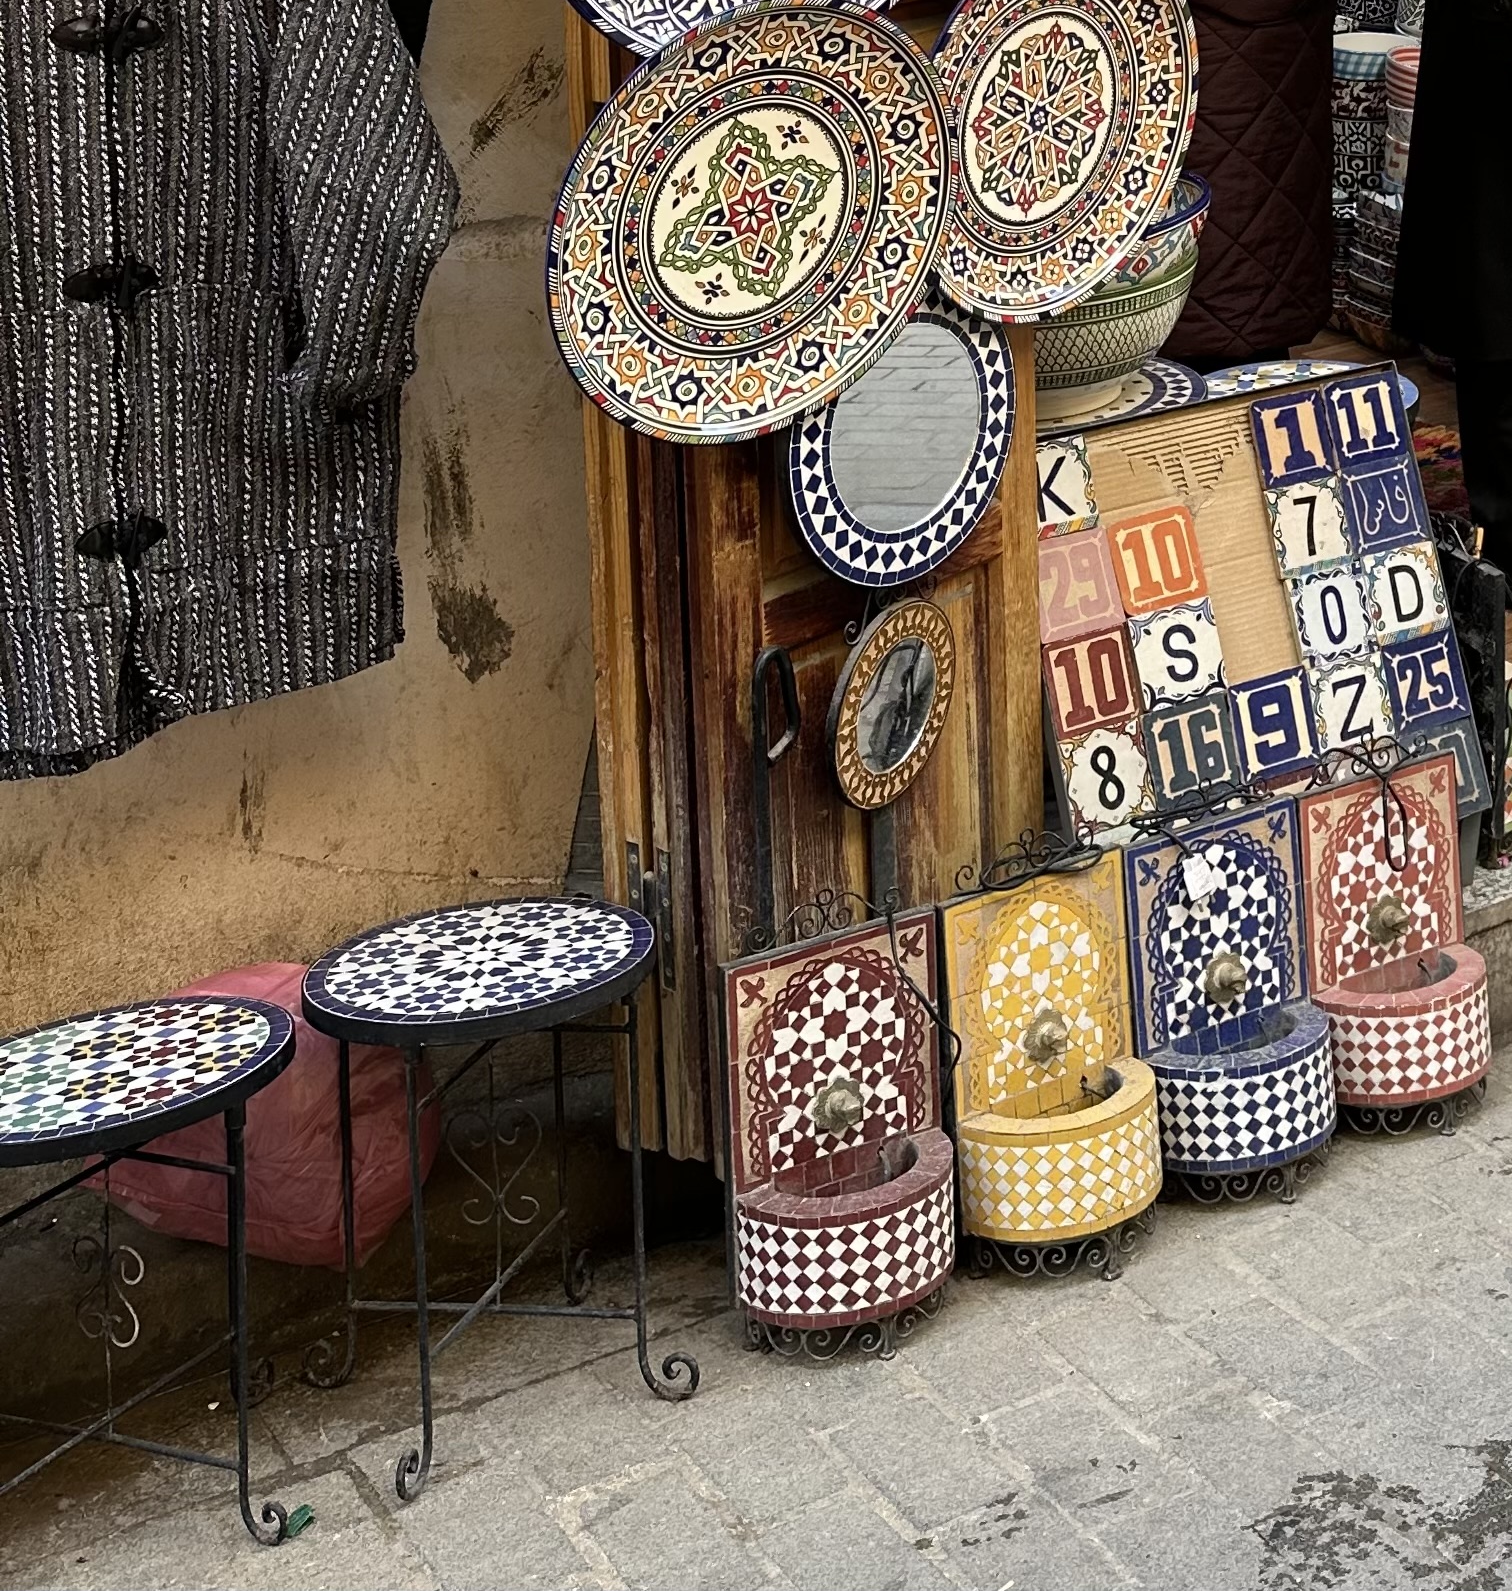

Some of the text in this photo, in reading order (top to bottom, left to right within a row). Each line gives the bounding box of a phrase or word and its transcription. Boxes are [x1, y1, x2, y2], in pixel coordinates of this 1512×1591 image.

[1273, 406, 1318, 474] 1
[1337, 384, 1396, 452] 11
[1036, 455, 1076, 523] K
[1292, 495, 1318, 557] 7
[1039, 542, 1111, 625] 29
[1121, 519, 1194, 602] 10
[1387, 564, 1424, 623] D
[1053, 637, 1130, 729] 10
[1161, 623, 1199, 683] S
[1396, 646, 1454, 717] 25
[1247, 681, 1302, 767] 9
[1331, 673, 1375, 742] Z
[1089, 744, 1126, 811] 8
[1158, 709, 1228, 793] 16
